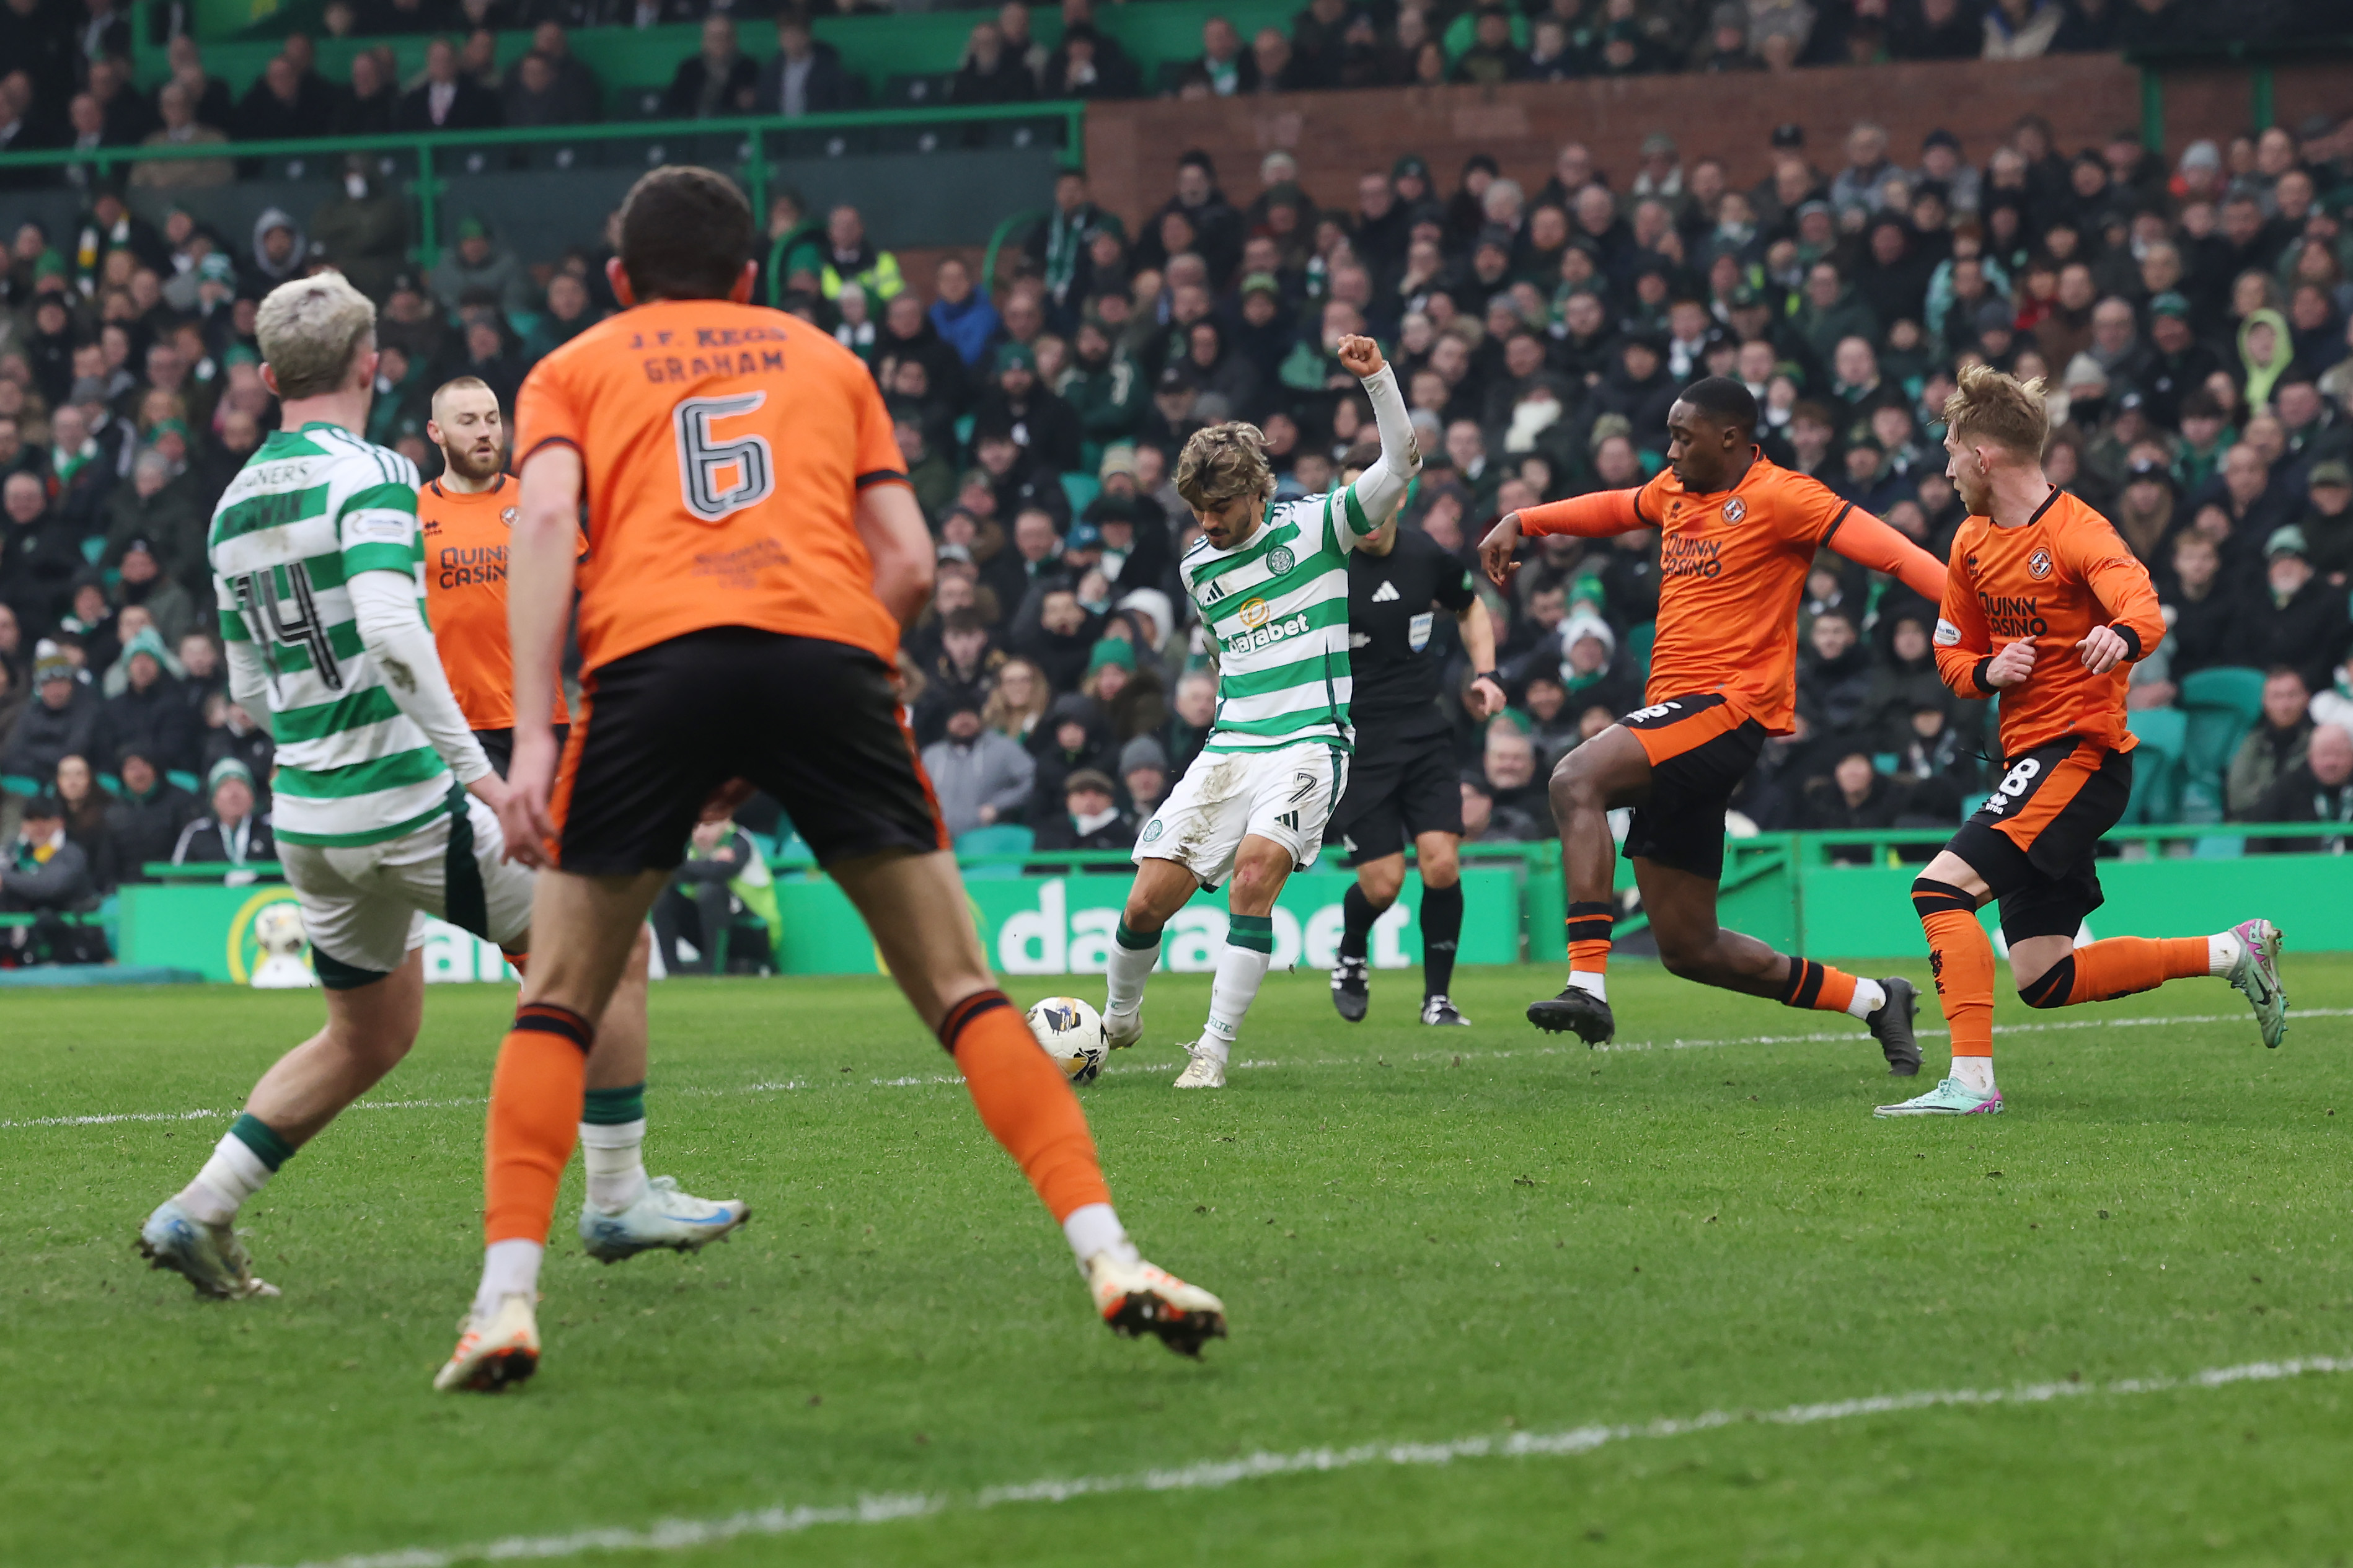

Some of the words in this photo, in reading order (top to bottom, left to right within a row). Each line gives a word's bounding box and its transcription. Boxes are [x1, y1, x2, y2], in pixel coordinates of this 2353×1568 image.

[643, 350, 785, 384] GRAHAM
[672, 389, 775, 522] 6
[1666, 533, 1722, 558] QUINN
[439, 563, 508, 590] CASIN
[234, 560, 344, 703] 14
[1990, 617, 2048, 637] ASINO
[1287, 772, 1318, 804] 7
[999, 877, 1412, 976] daaet
